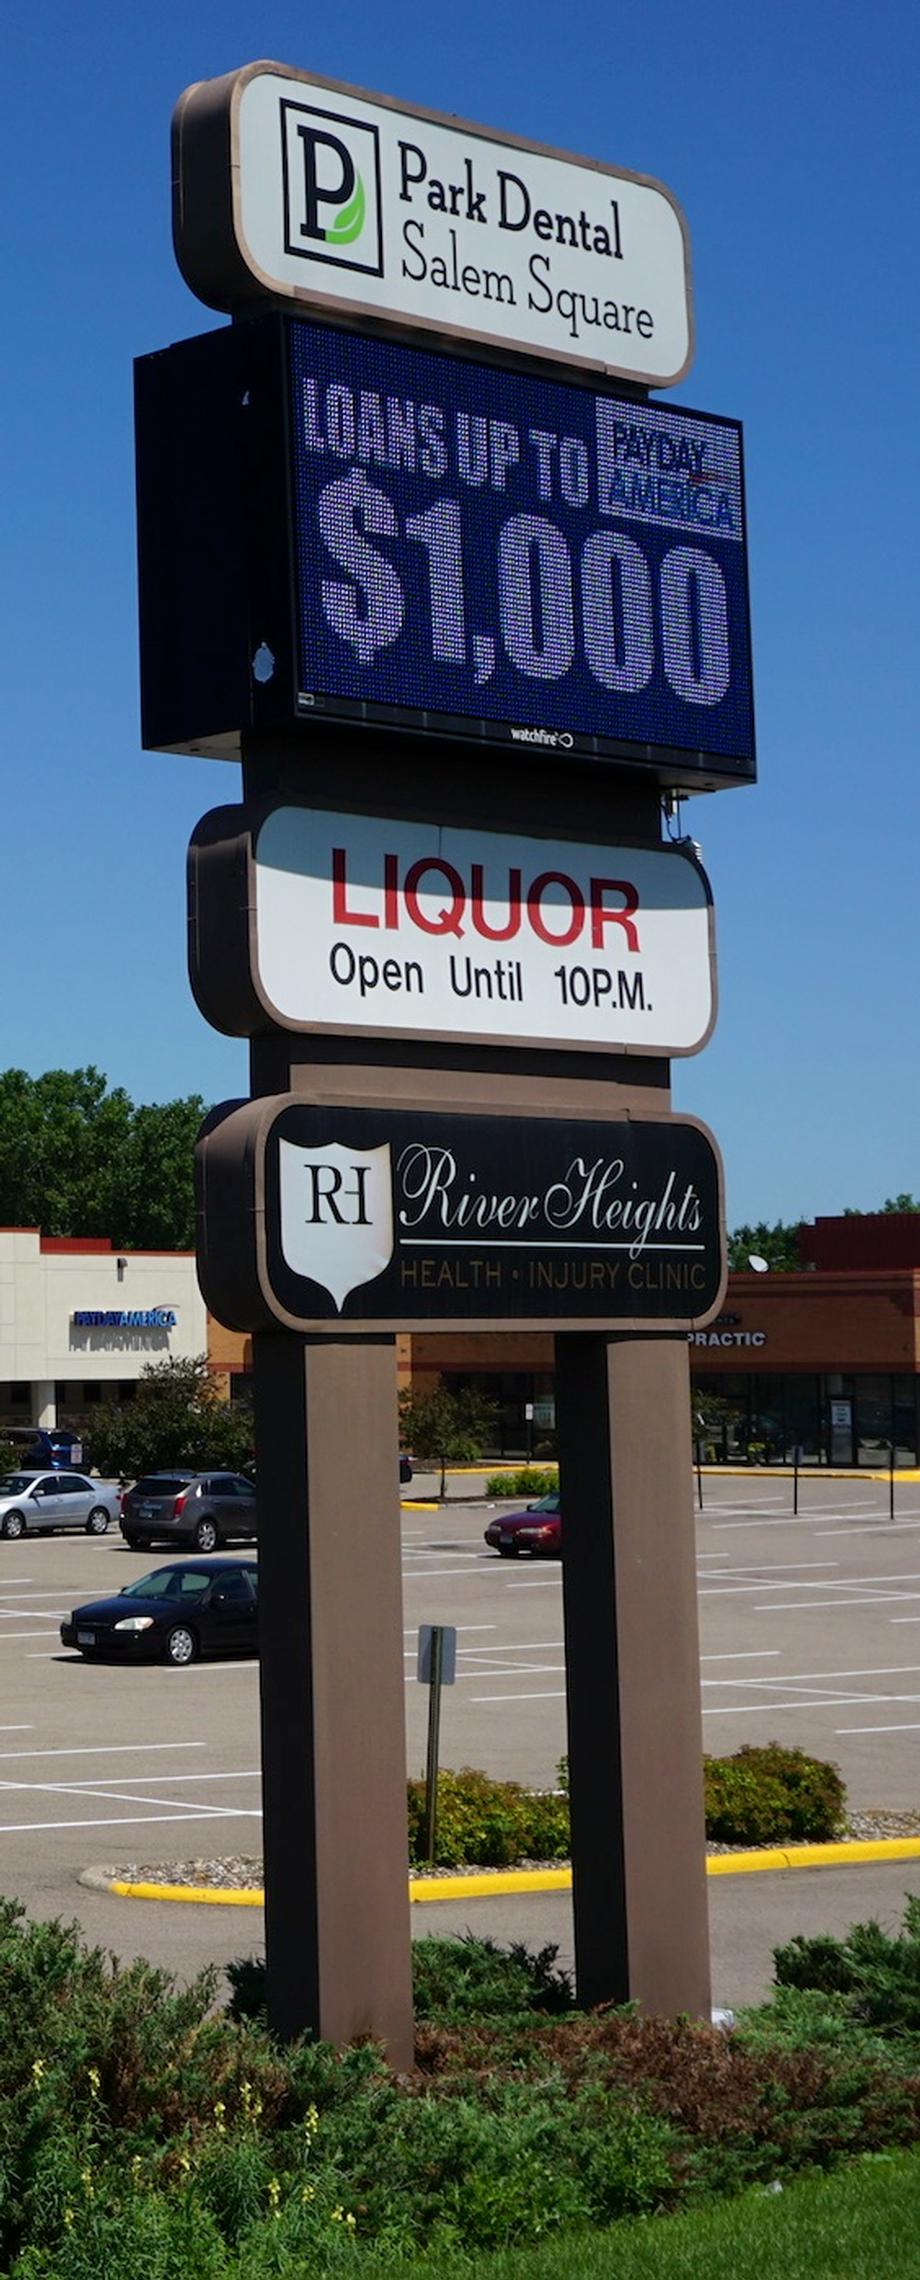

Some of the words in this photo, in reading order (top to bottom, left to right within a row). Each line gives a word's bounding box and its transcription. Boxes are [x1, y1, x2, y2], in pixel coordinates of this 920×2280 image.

[297, 124, 356, 241] P
[398, 140, 487, 224] Park
[496, 169, 624, 259] Dental
[401, 218, 517, 306] Salem
[527, 253, 654, 339] Square
[303, 377, 449, 479] LOANS
[457, 412, 520, 492] UP
[528, 428, 590, 509] TO
[613, 420, 707, 473] PAYDAY
[318, 466, 731, 706] $1,000
[511, 728, 557, 746] watchfire
[332, 847, 641, 953] LIQUOR
[329, 942, 424, 996] Open
[449, 955, 523, 1002] Until
[554, 965, 654, 1011] 10P.M.
[397, 1143, 541, 1229] River
[544, 1157, 702, 1260] Heights
[401, 1259, 501, 1288] HEALTH
[529, 1261, 621, 1289] INJURY
[627, 1263, 706, 1289] CLINIC
